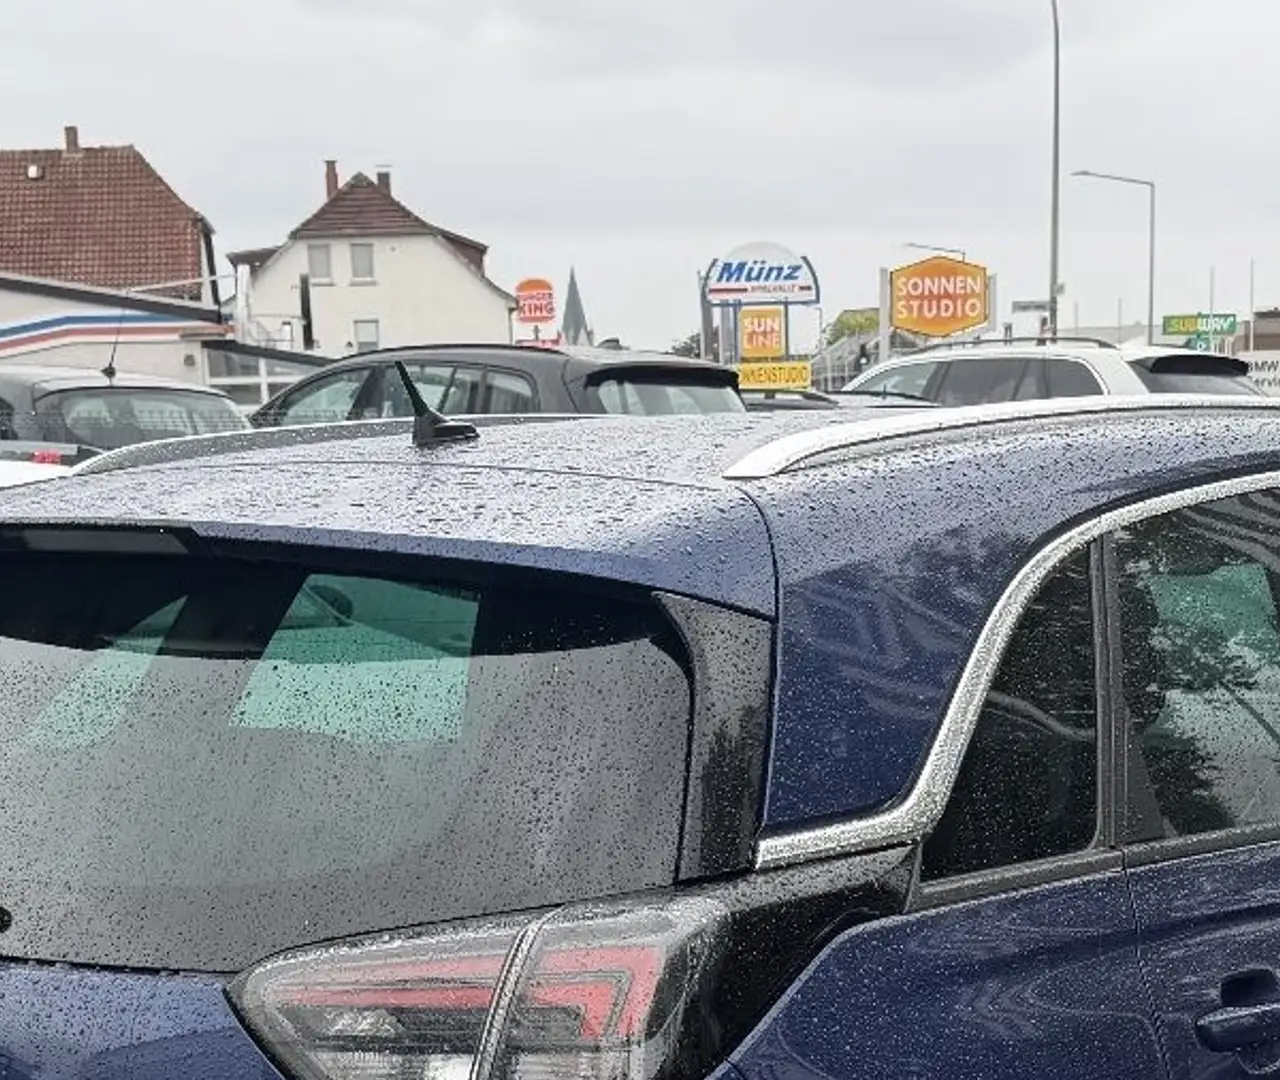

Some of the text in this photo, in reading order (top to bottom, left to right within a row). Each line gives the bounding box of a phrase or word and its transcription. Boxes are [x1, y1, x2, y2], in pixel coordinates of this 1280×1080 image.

[716, 259, 803, 283] Münz
[896, 275, 982, 297] SONNEN
[897, 299, 982, 320] STUDIO
[743, 316, 780, 333] SUN
[1168, 314, 1234, 333] SUBWAY
[744, 333, 780, 350] LINE
